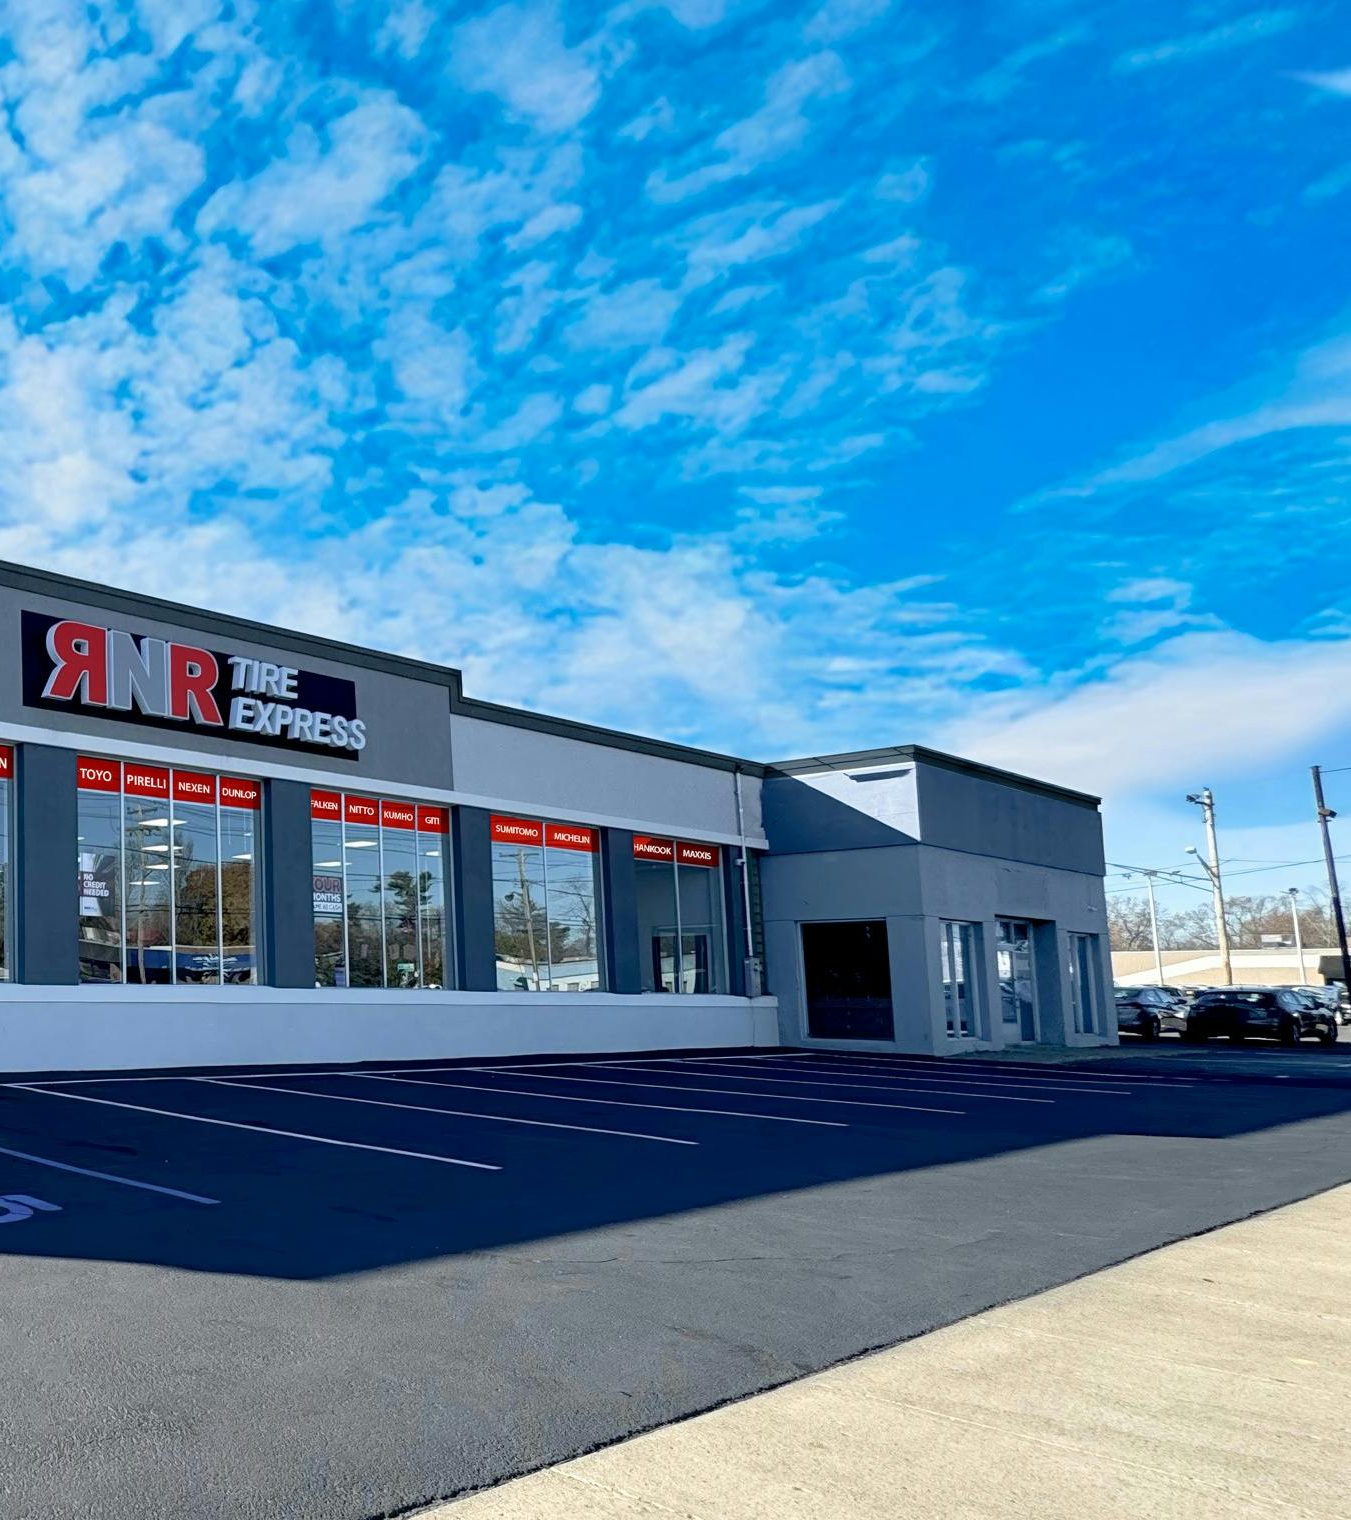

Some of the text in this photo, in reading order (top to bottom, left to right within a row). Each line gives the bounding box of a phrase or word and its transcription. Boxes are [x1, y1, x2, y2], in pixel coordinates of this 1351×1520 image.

[41, 619, 225, 727] RNR
[227, 655, 300, 700] TIRE
[228, 696, 367, 751] EXPRESS
[79, 768, 113, 782] TOYO
[126, 774, 167, 789] PIRELLI
[178, 781, 211, 794] NEXEN
[222, 787, 257, 800] DUNLOP
[310, 800, 339, 811] FALKEN
[349, 804, 375, 816] NITTO
[383, 810, 414, 822] KUMHO
[495, 824, 539, 837] SUMITOMO
[553, 832, 590, 844] MICHELIN
[633, 843, 672, 855] HANKOOK
[682, 849, 712, 861] MAXXIS
